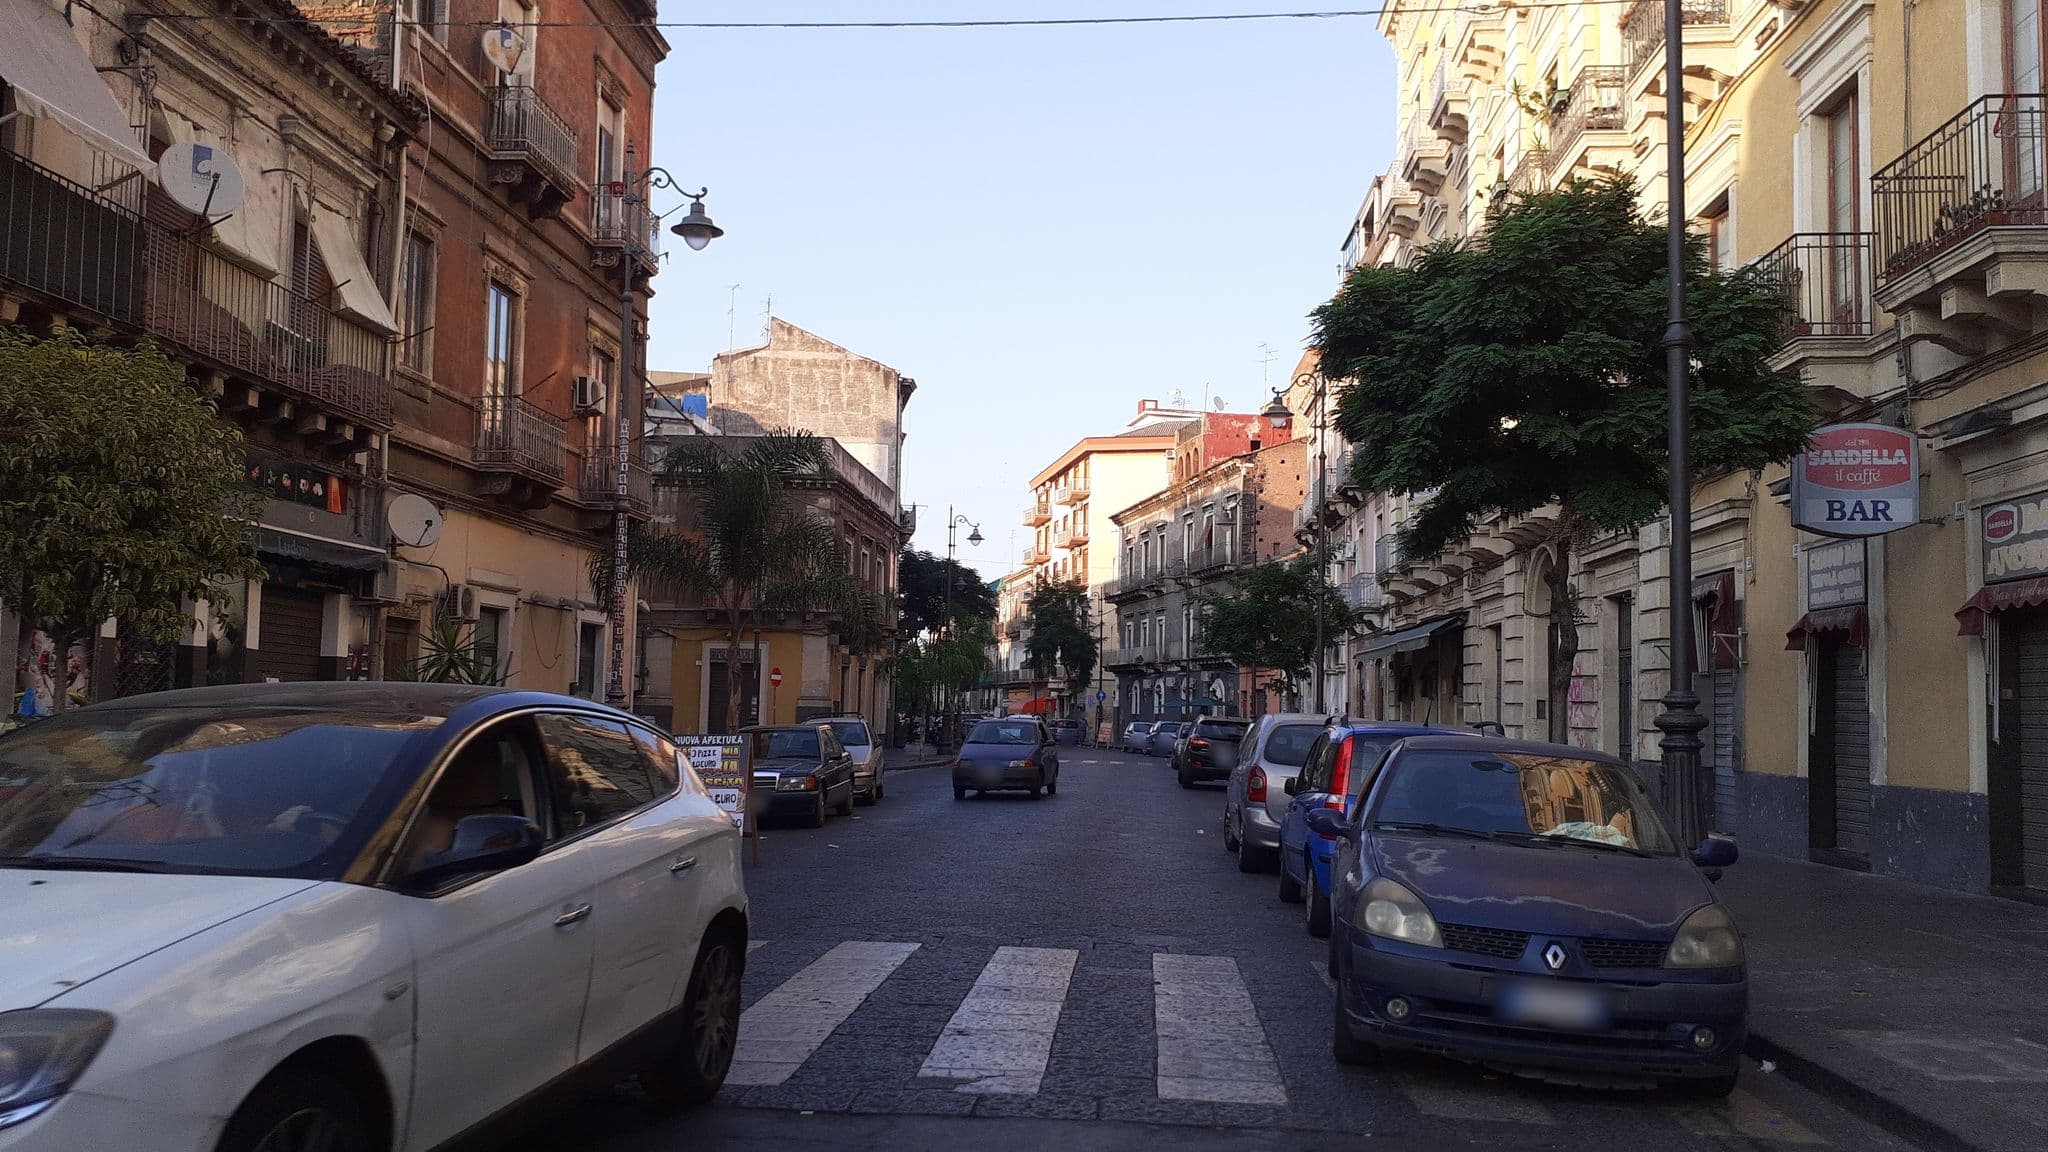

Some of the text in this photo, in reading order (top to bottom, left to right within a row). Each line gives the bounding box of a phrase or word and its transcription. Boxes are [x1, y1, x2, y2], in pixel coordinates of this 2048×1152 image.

[1808, 449, 1908, 466] SARDELLA
[1835, 469, 1843, 481] il
[1825, 500, 1893, 521] BAR
[675, 735, 742, 744] NUOVA APERTURA
[714, 794, 737, 804] EURO
